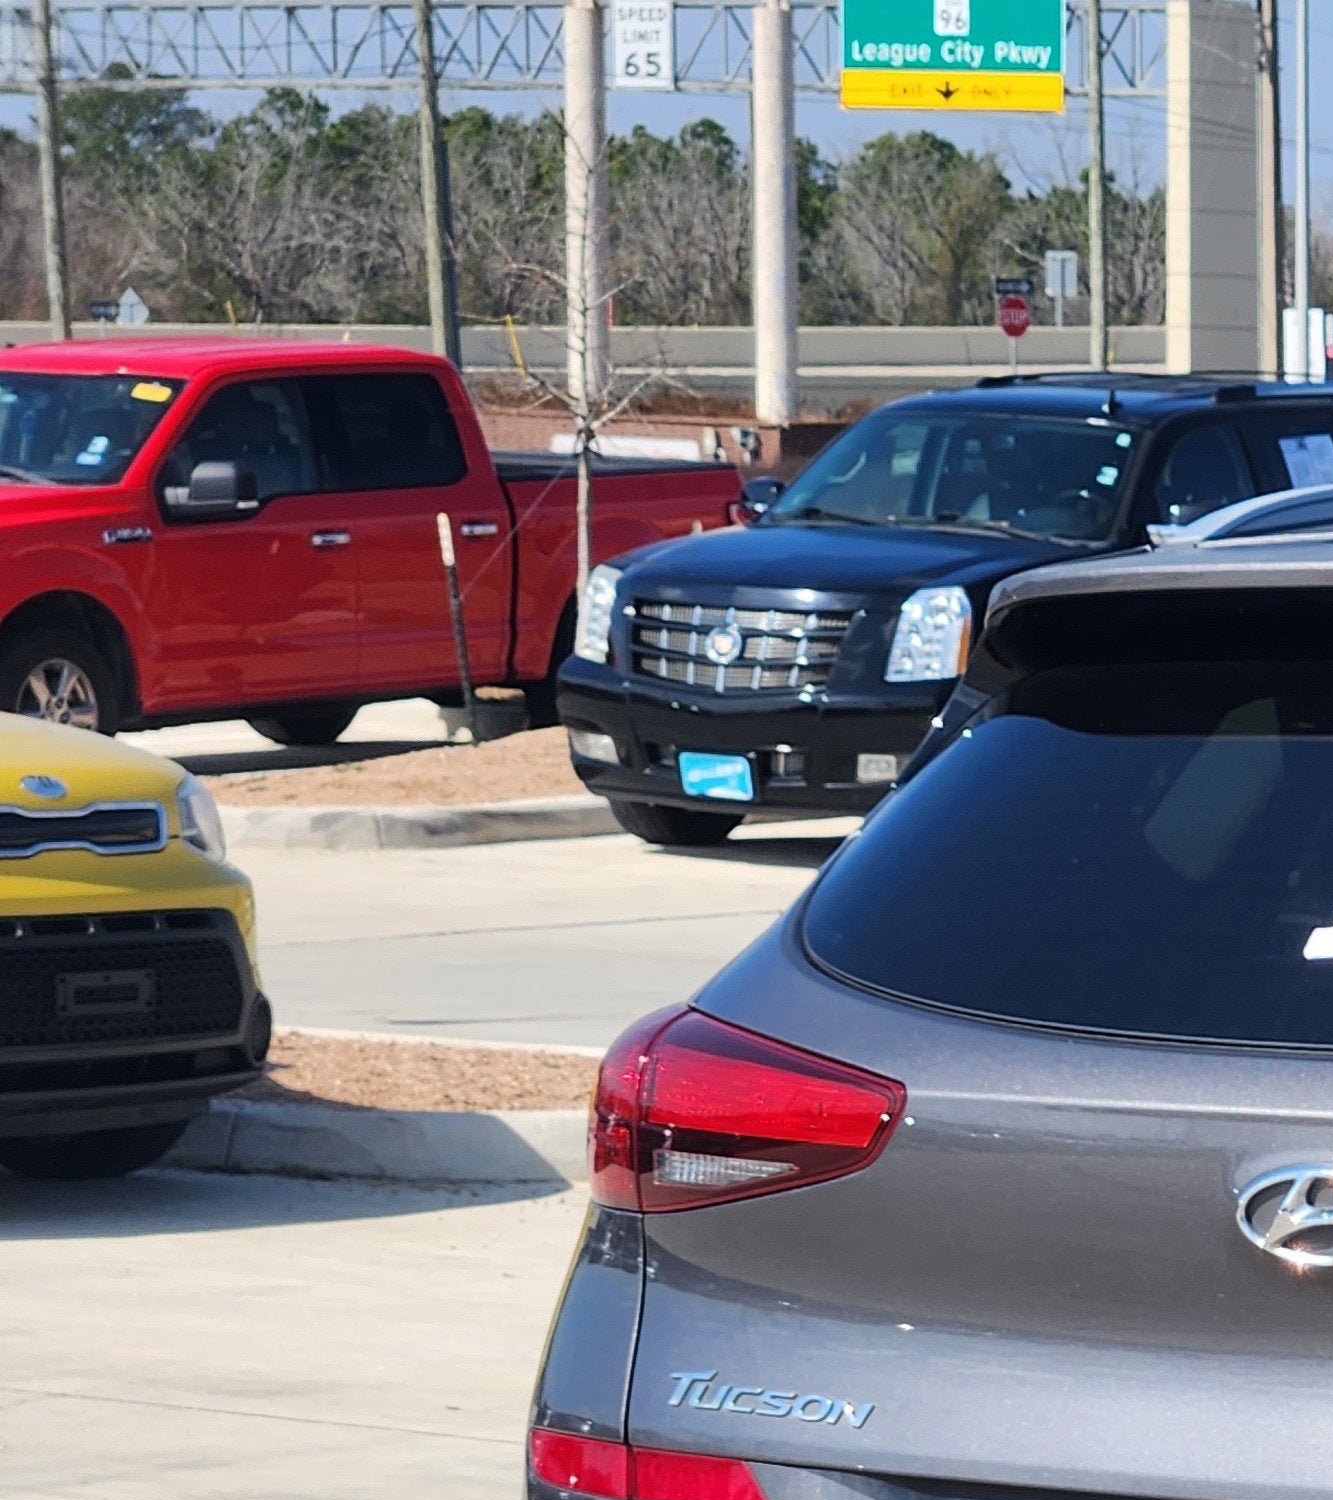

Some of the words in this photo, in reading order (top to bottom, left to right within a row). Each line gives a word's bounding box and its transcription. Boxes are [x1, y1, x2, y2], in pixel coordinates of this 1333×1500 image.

[618, 7, 666, 22] SPEED
[940, 9, 967, 30] 96
[622, 30, 660, 44] LIMIT
[625, 51, 662, 77] 65
[851, 40, 931, 67] League
[940, 39, 985, 69] City
[994, 40, 1052, 70] Pkwy
